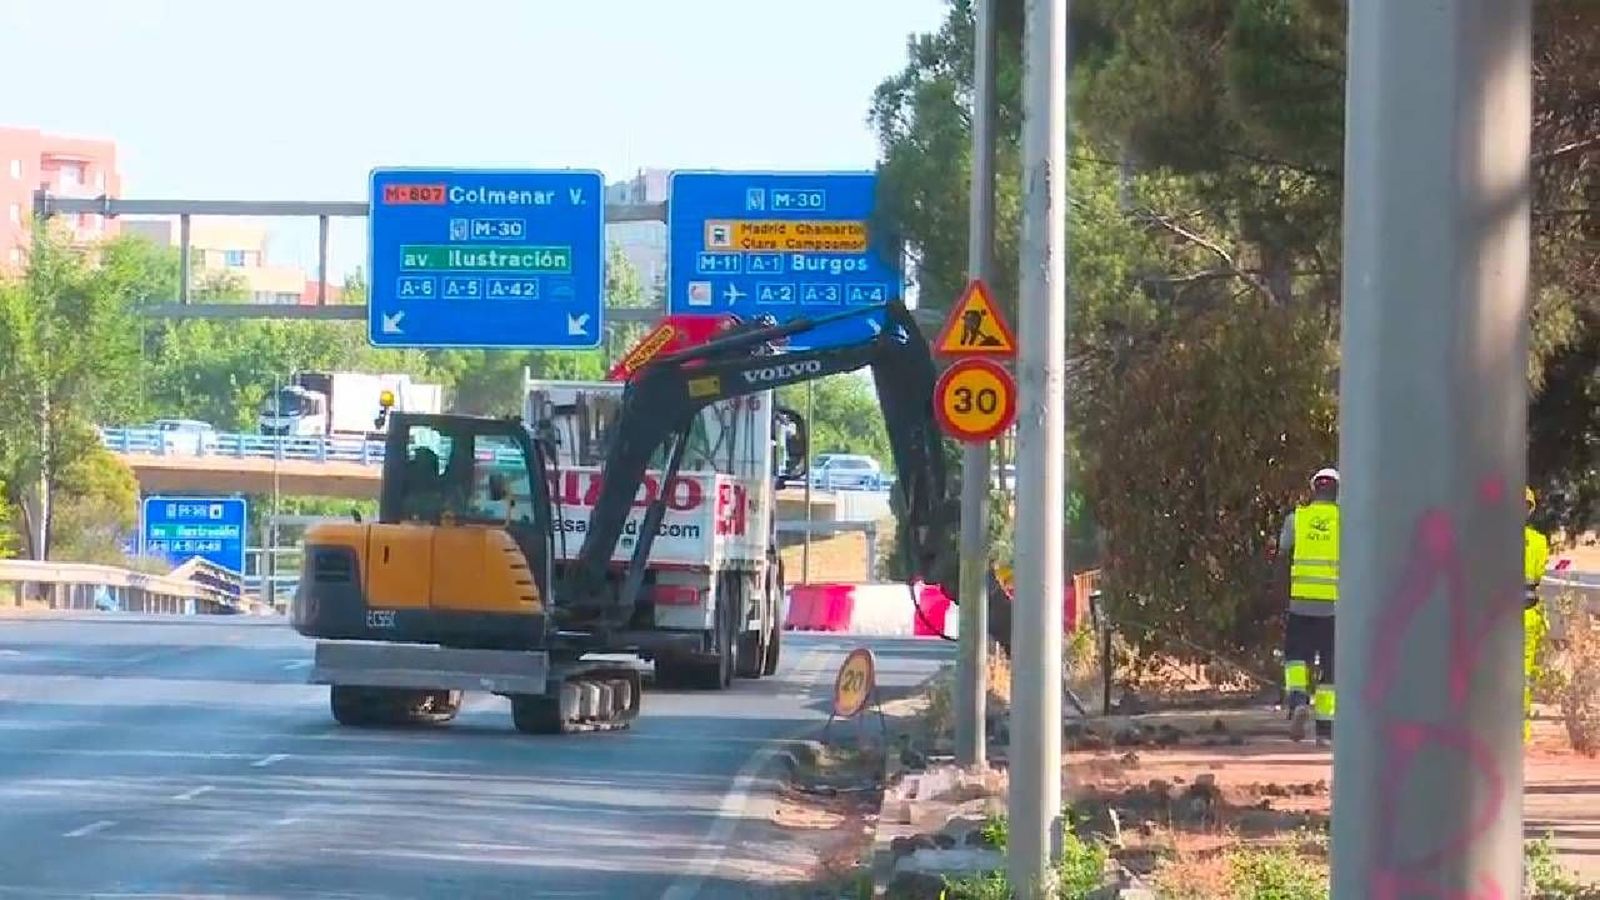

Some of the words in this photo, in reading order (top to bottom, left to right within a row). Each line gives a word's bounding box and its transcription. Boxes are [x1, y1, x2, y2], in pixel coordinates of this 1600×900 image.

[449, 186, 555, 204] Colmenar
[569, 187, 587, 205] V.
[775, 193, 821, 207] M-30
[475, 221, 522, 236] M-30
[740, 223, 786, 235] Madrid
[449, 250, 567, 268] Ilustración
[701, 256, 738, 270] M-11
[752, 257, 778, 270] A-1
[790, 255, 868, 274] Burgos
[401, 280, 432, 295] A-6
[446, 281, 477, 296] A-5
[490, 282, 535, 296] A-42
[760, 286, 791, 301] A-2
[806, 287, 837, 301] A-3
[851, 287, 882, 301] A-4
[743, 360, 821, 382] VOLVO
[954, 387, 997, 415] 30
[841, 669, 865, 692] 20
